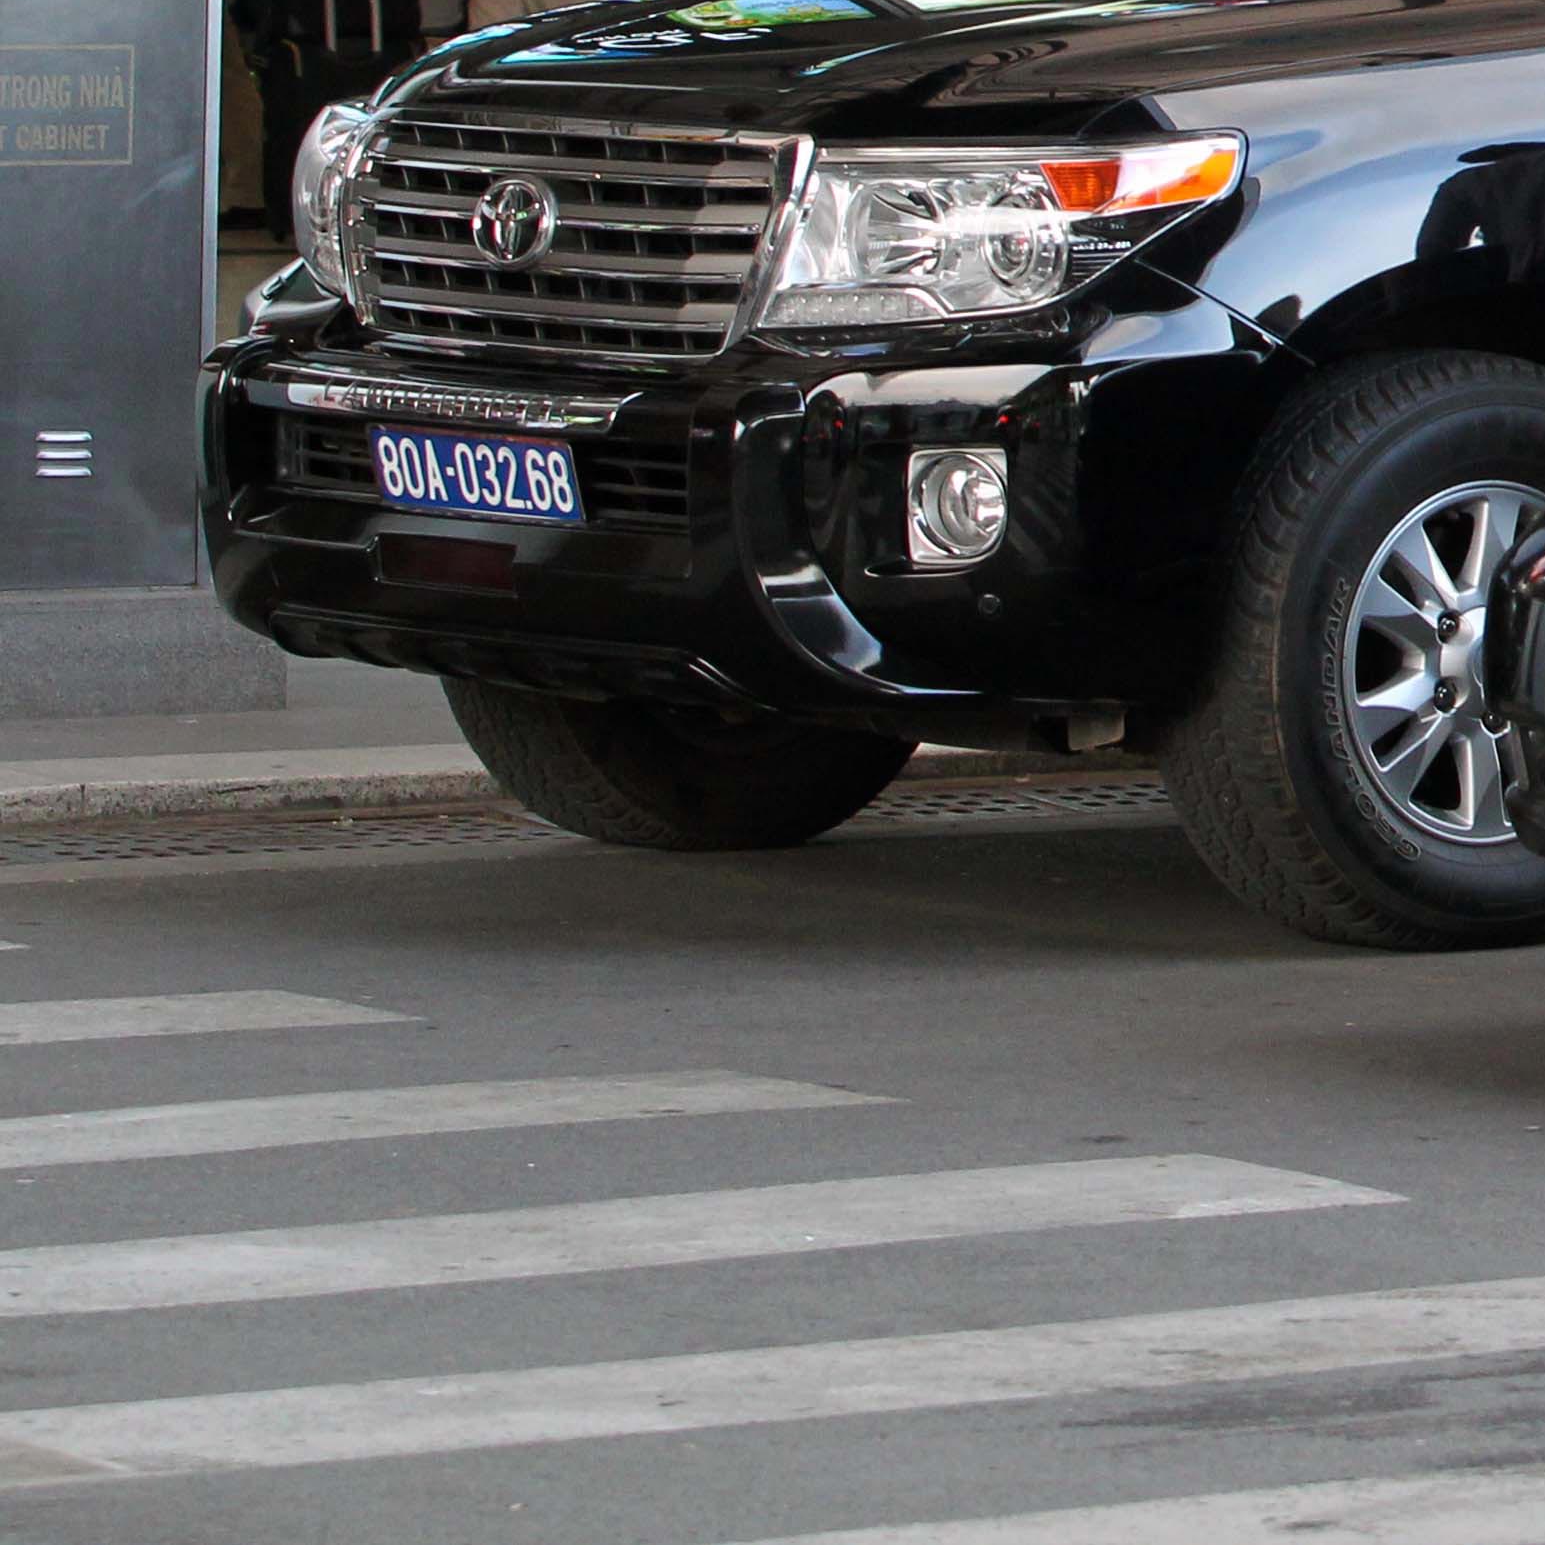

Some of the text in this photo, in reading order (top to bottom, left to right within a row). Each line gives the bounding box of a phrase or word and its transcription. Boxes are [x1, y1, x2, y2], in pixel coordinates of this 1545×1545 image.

[0, 73, 72, 108] TRONG
[16, 124, 110, 153] CABINET
[377, 434, 574, 514] 80A-032.68
